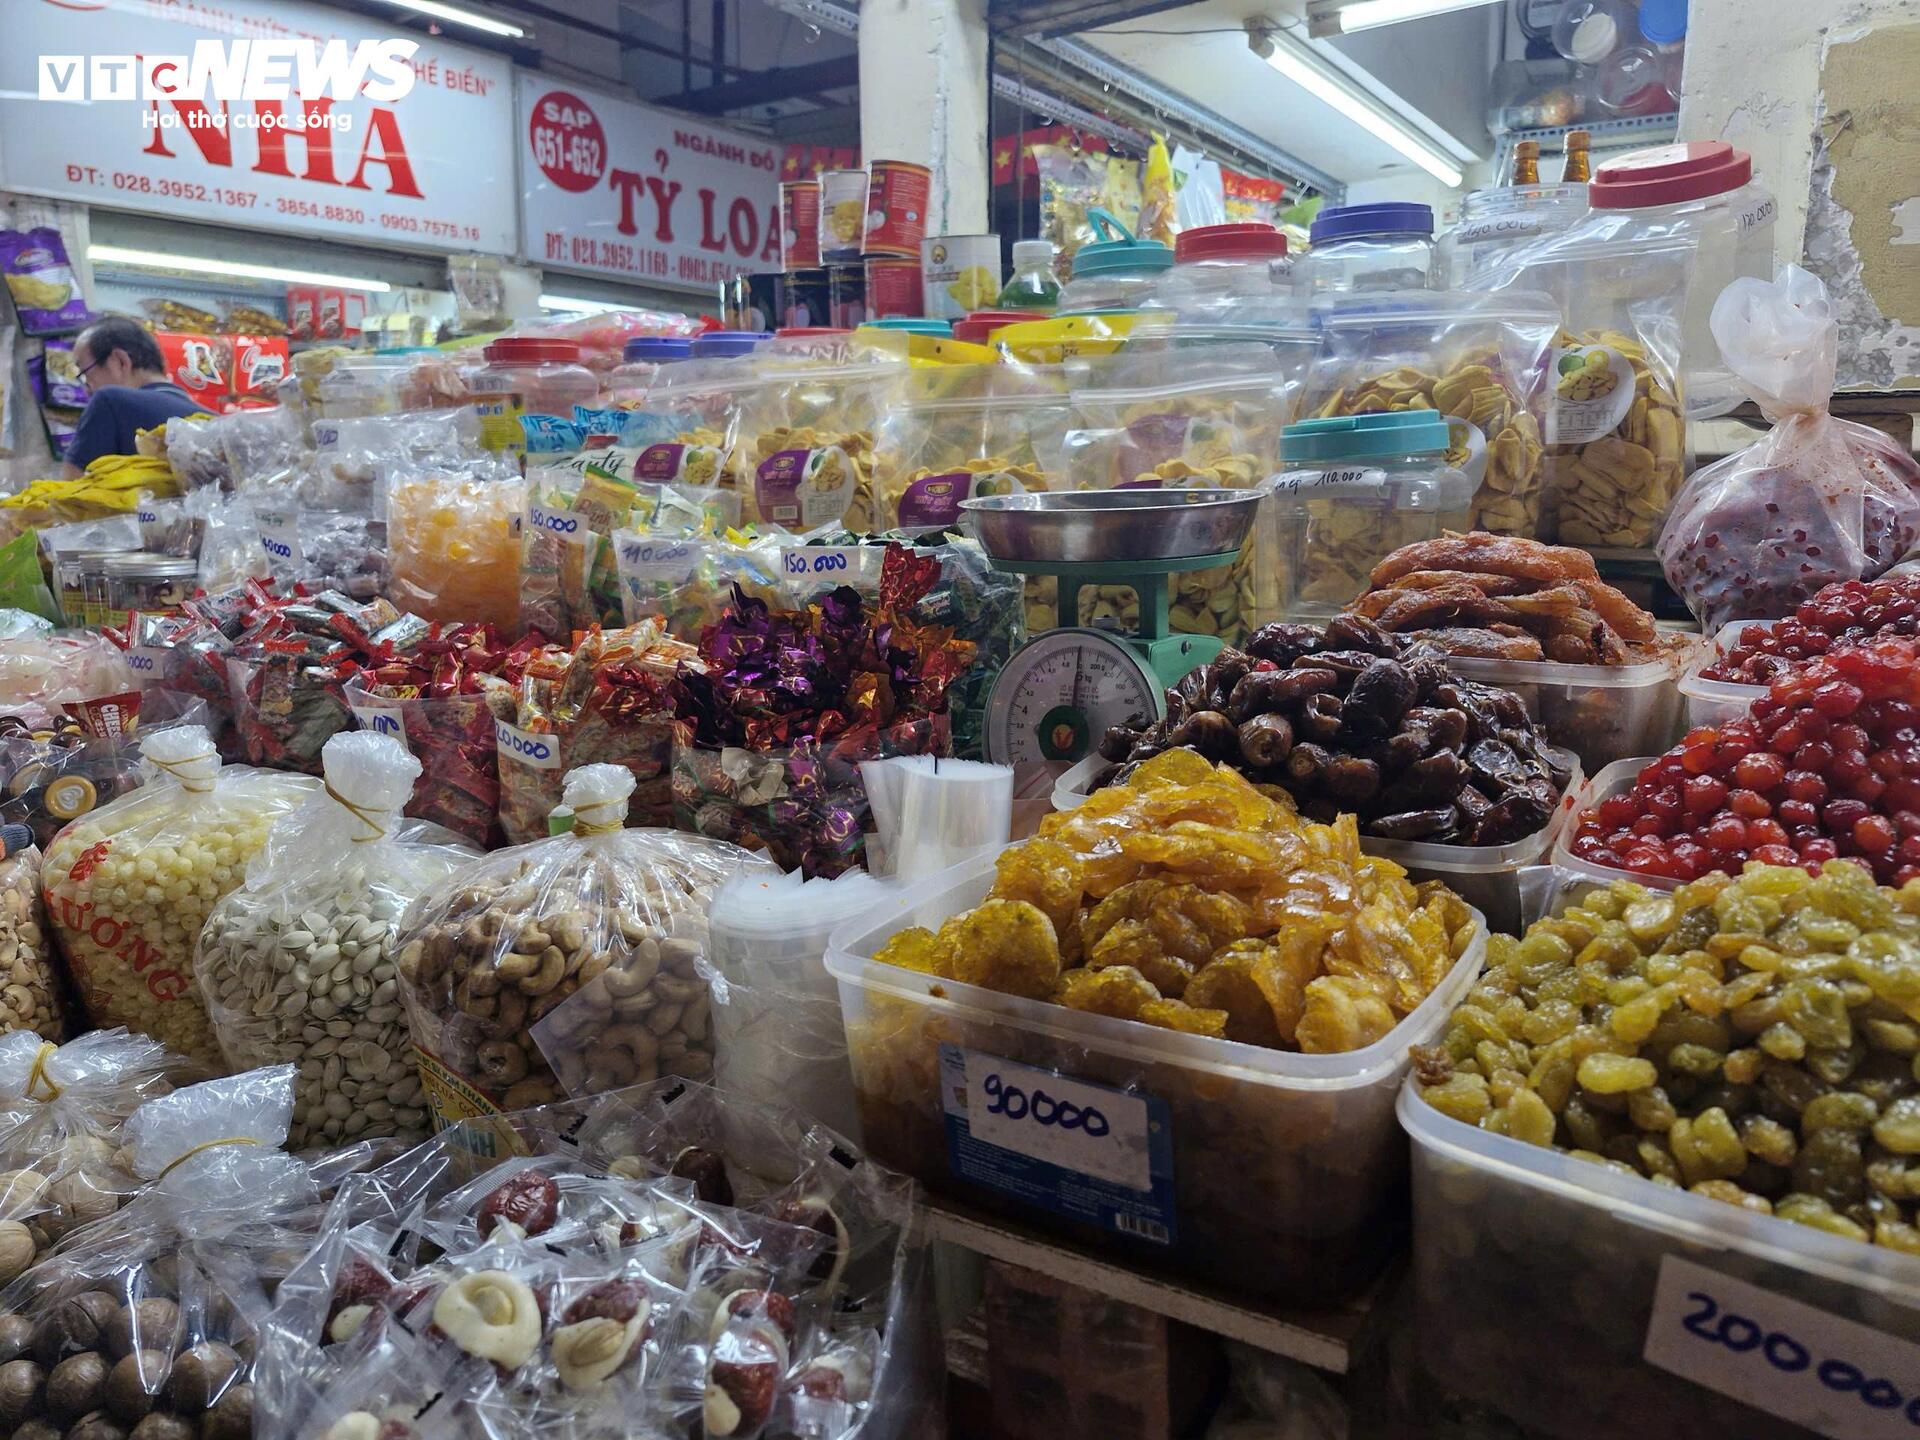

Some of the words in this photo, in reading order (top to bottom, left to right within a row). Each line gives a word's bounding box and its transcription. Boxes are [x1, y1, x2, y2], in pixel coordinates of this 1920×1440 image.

[542, 101, 593, 131] SẠP
[534, 124, 601, 178] 651-652
[66, 164, 105, 188] ĐT:
[112, 171, 258, 208] 028.3952.1367
[277, 198, 365, 225] 3854.8830
[380, 213, 481, 242] 0903.7575.16
[529, 508, 578, 533] 150.000
[783, 552, 848, 575] 150.000
[983, 1073, 1110, 1138] 90000
